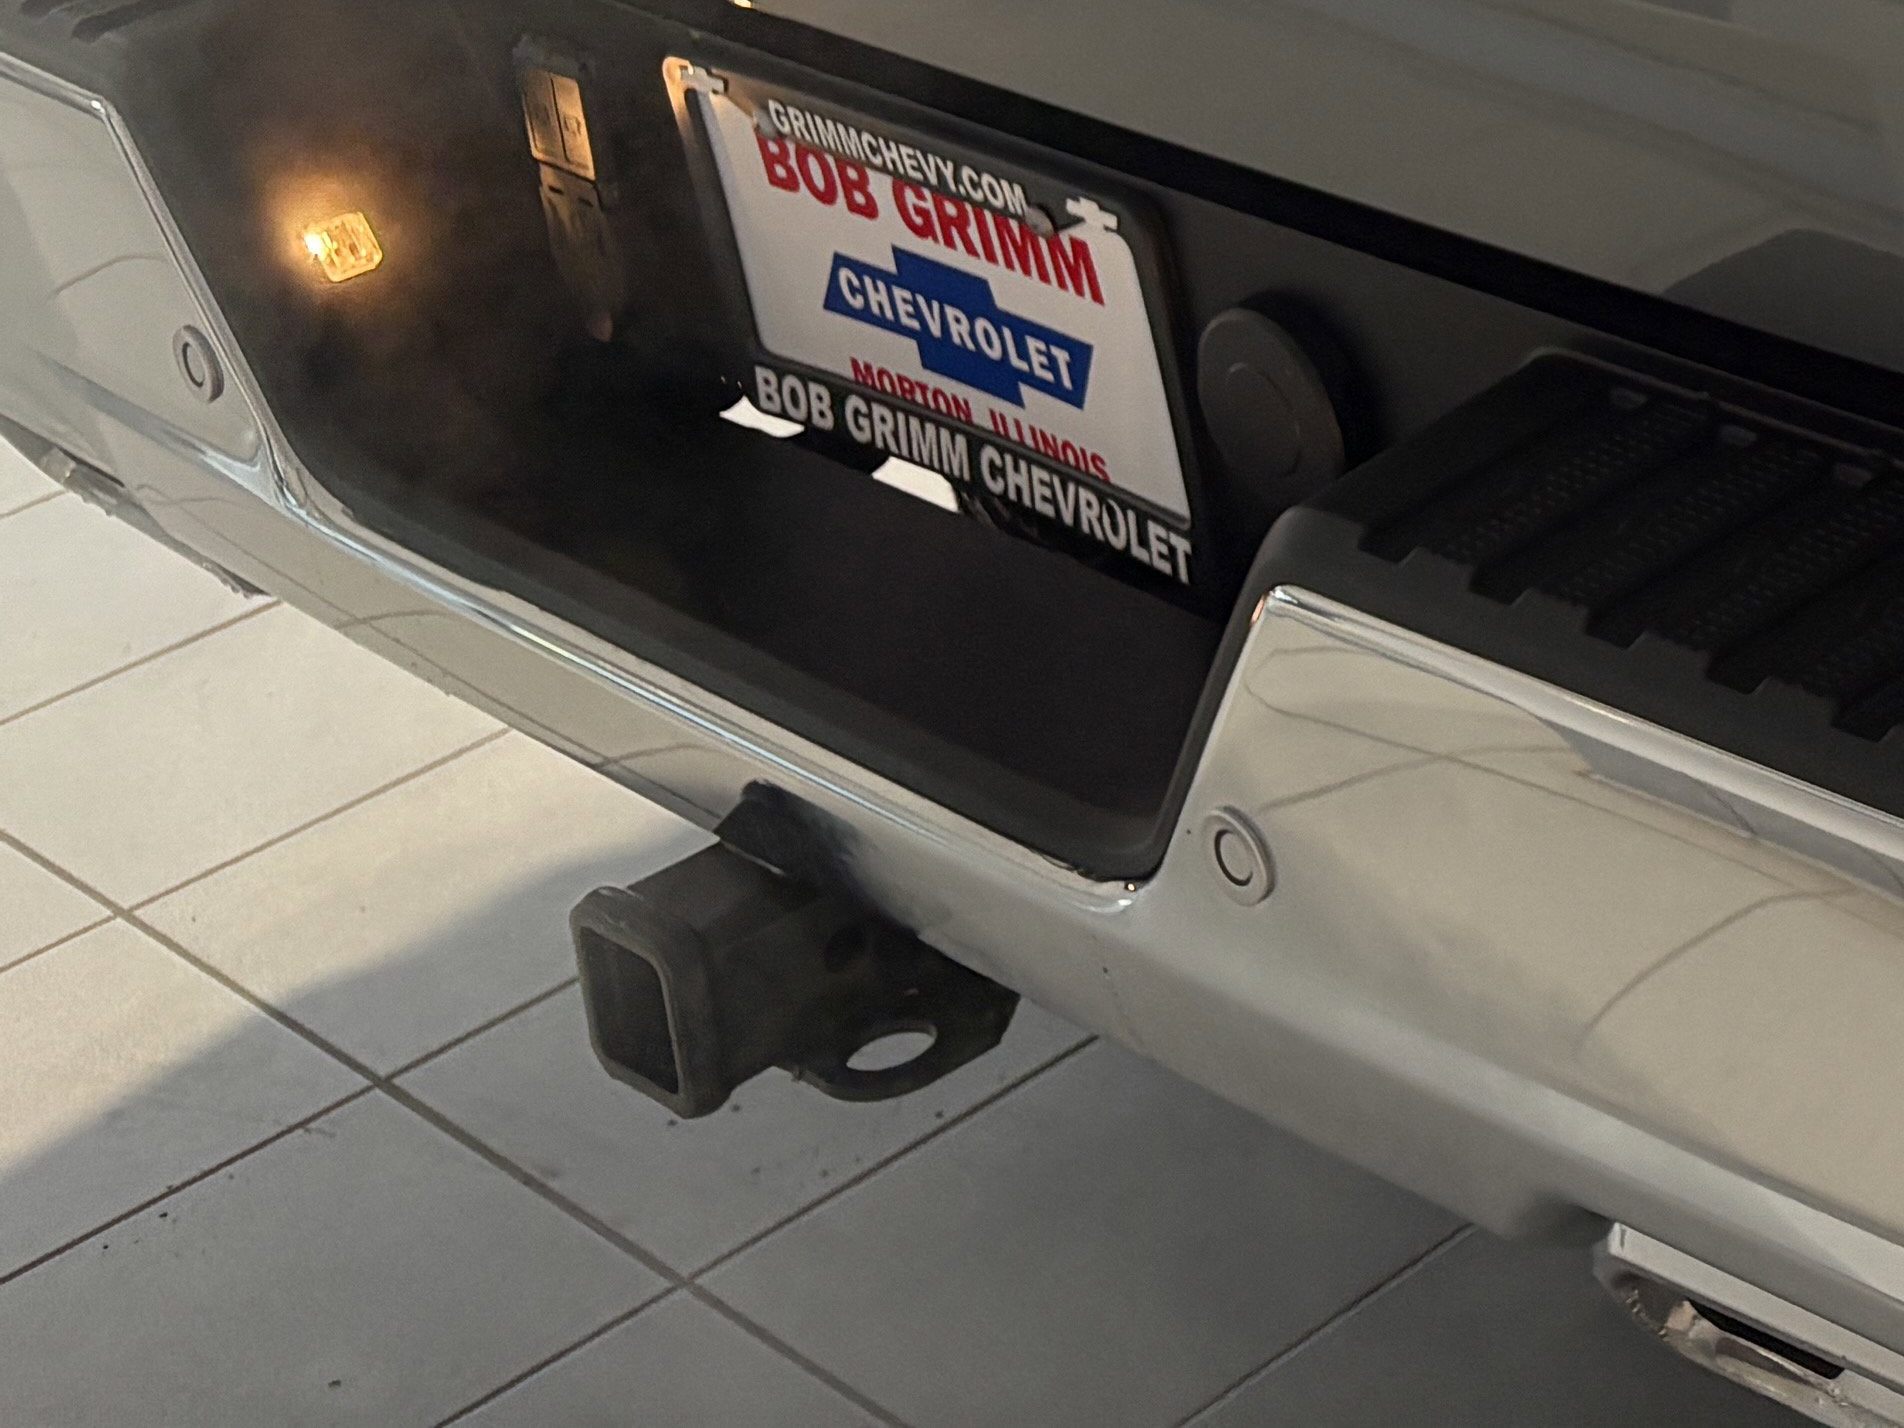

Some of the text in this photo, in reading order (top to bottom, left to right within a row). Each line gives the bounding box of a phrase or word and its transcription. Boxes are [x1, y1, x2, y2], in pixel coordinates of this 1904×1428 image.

[755, 132, 1106, 307] BOB GRIMM
[767, 98, 1030, 218] GRIMMCHEVY.COM
[837, 266, 1073, 392] CHEVROLET
[753, 365, 1193, 586] BOB GRIMM CHEVROLET
